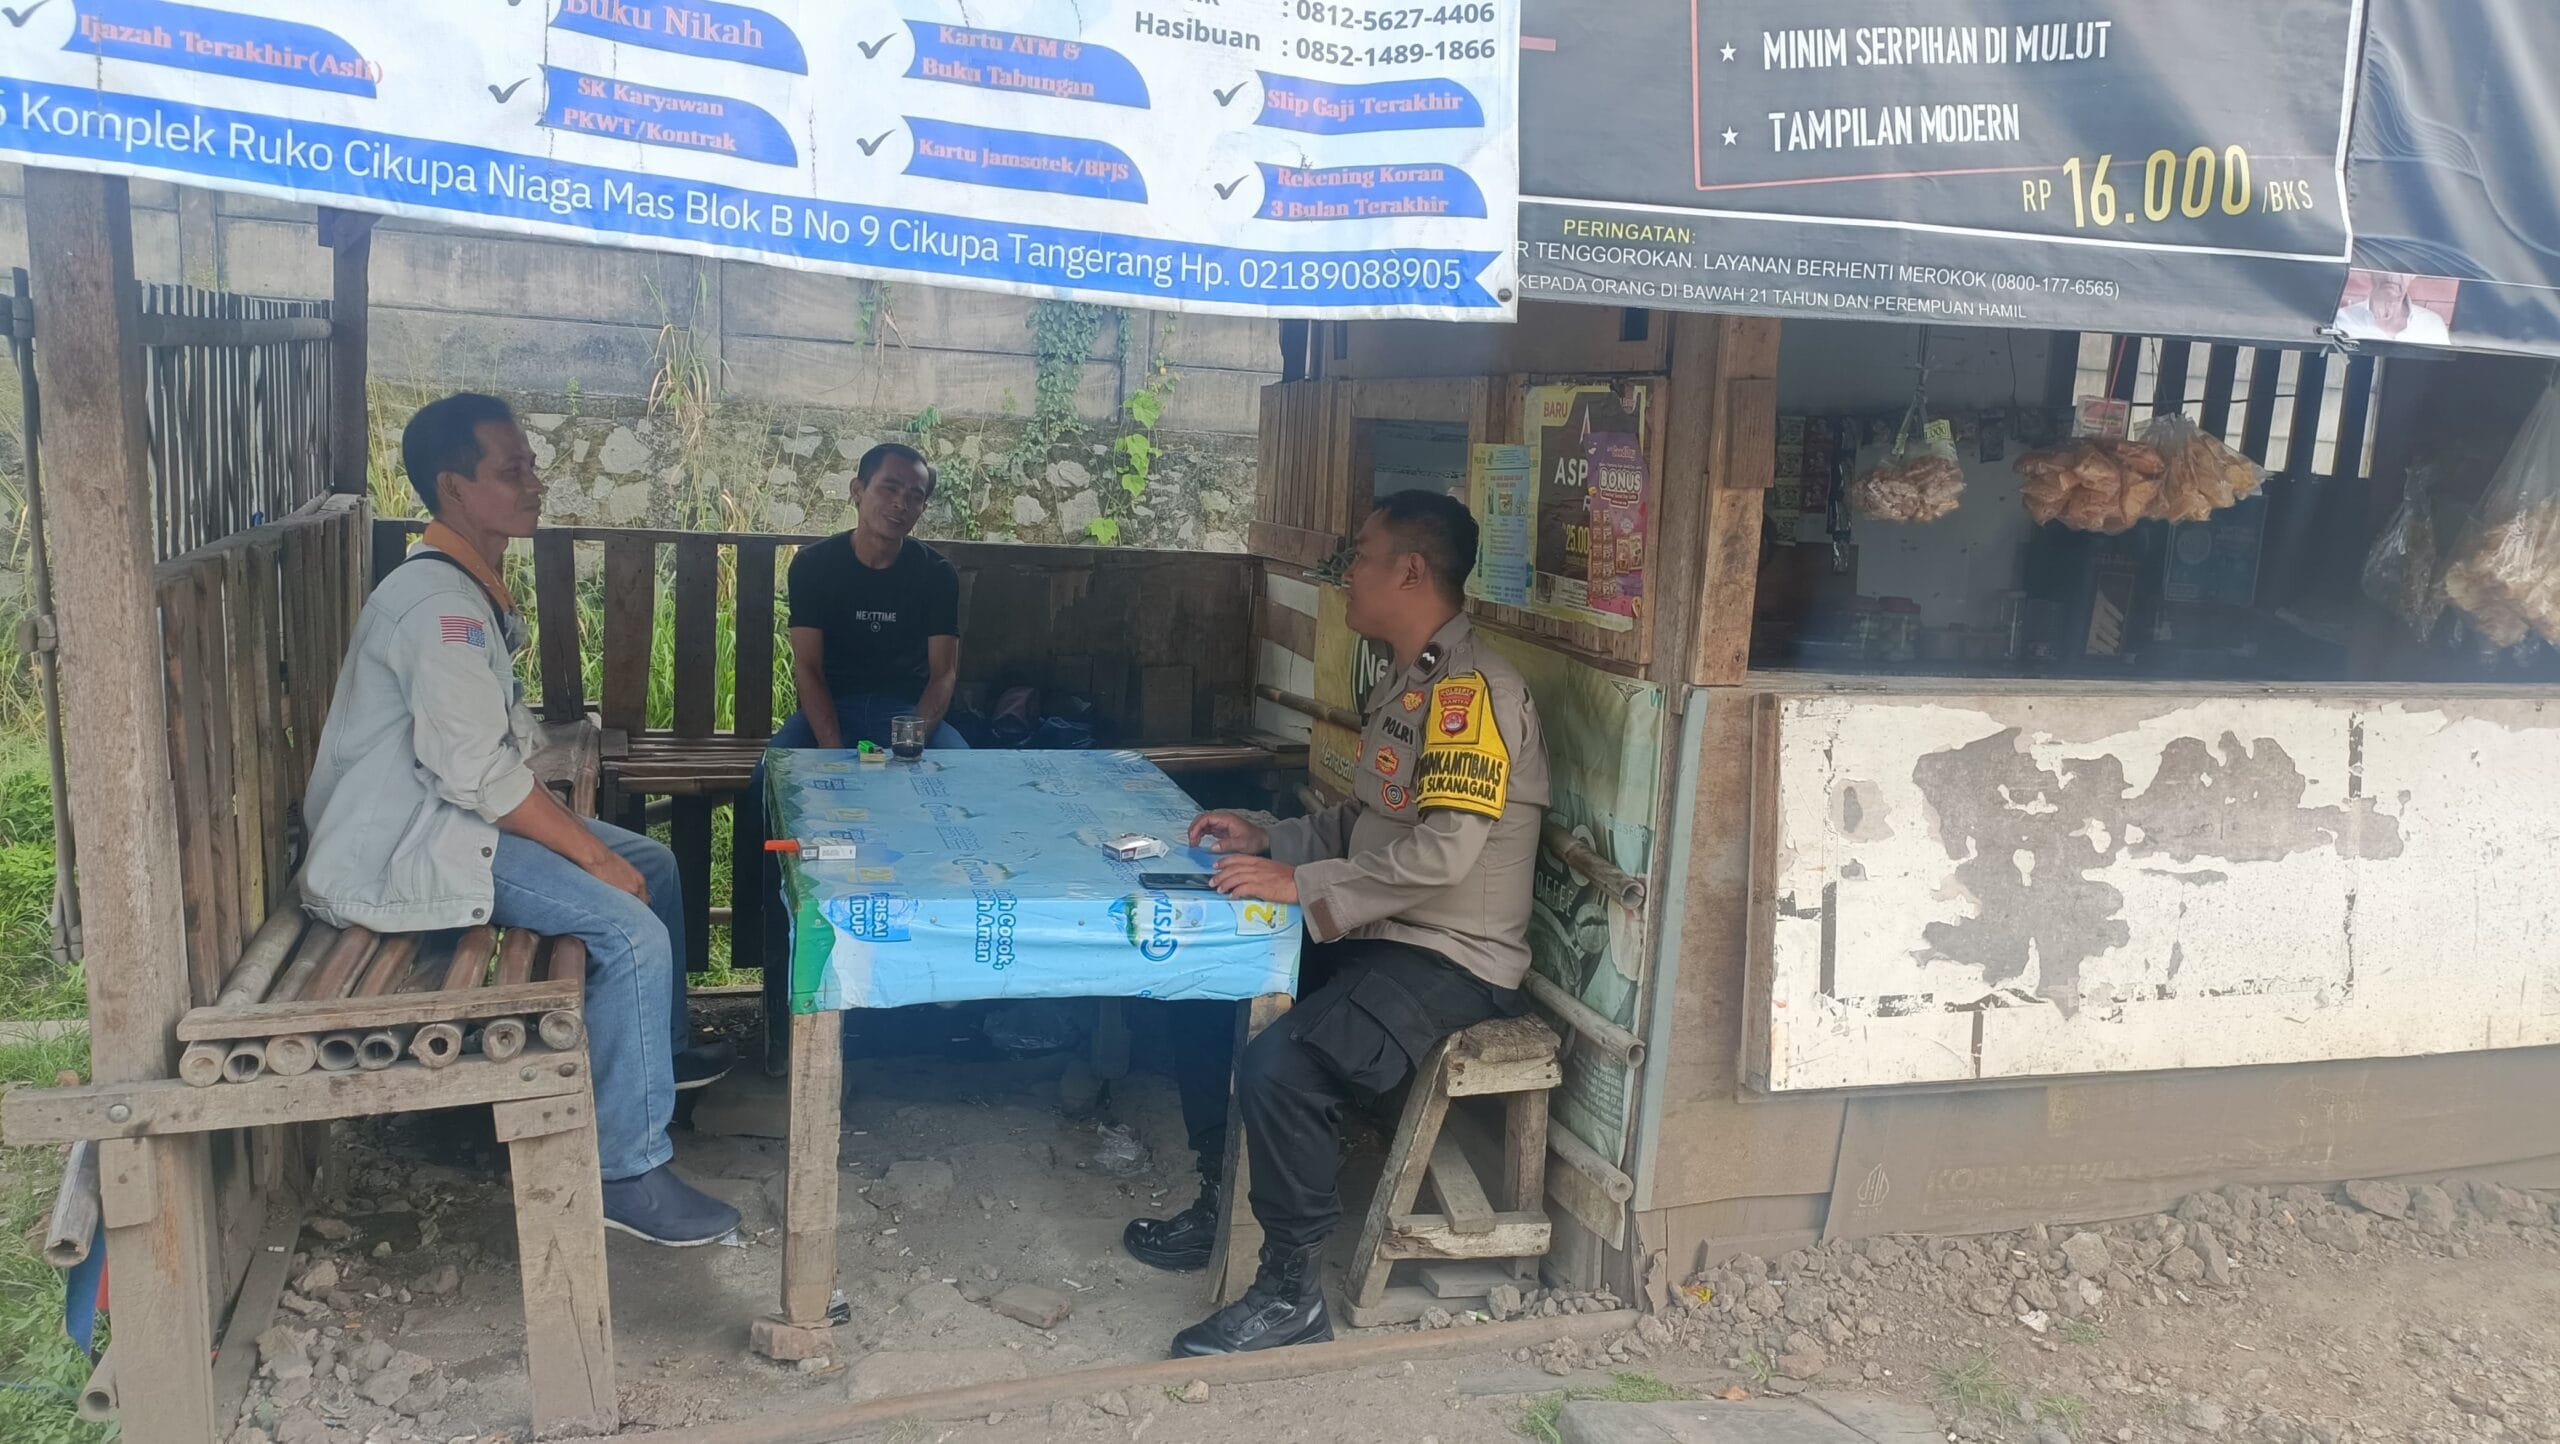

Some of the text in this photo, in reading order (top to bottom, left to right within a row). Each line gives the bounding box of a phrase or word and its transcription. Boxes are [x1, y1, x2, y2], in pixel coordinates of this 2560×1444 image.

[662, 6, 764, 49] Nikah
[1296, 0, 1495, 31] 0812-5627-4406
[80, 14, 384, 84] Ijazah Terakhir(Asli)
[939, 25, 1081, 61] Kartu ATM &
[1135, 11, 1261, 51] Hasibuan
[1296, 37, 1496, 67] 0852-1489-1866
[1763, 21, 2112, 70] MINIM SERPIHAN DI MULUT
[578, 77, 724, 117] SK Karyawan
[922, 56, 1095, 98] Buku Tabungan
[1268, 88, 1464, 123] Slip Gaji Terakhir
[563, 107, 738, 152] PKWT/Kontrak
[1768, 103, 2020, 152] TAMPILAN MODERN
[919, 138, 1130, 182] Kartu Jamsotek/BPJS
[1278, 166, 1445, 189] Rekening Koran
[22, 91, 217, 156] Komplek
[229, 122, 334, 172] Ruko
[344, 140, 478, 196] Cikupa
[488, 161, 593, 214] Niaga
[603, 178, 676, 221] Mas
[686, 190, 763, 233] Blok
[771, 204, 793, 237] B
[804, 208, 850, 244] No
[859, 214, 880, 247] 9
[889, 219, 1000, 266] Cikupa
[1007, 233, 1174, 287] Tangerang
[1180, 252, 1230, 291] Hp.
[1239, 257, 1461, 291] 02189088905
[2022, 144, 2314, 228] RP 16.000 /BKS
[1271, 197, 1449, 218] 3 Bulan Terakhir
[1563, 219, 1697, 245] PERINGATAN:
[1536, 241, 1698, 269] TENGGOROKAN.
[1704, 253, 1791, 275] LAYANAN
[1797, 259, 1894, 281] BERHENTI
[1900, 265, 1986, 288] MEROKOK
[1991, 272, 2120, 300] (0800-177-6565)
[1518, 274, 2027, 319] KEPADA ORANG DI BAWAH 21 TAHUN DAN PEREMPUAN HAMIL
[1543, 400, 1568, 418] BARU
[1600, 468, 1641, 492] BONUS
[856, 610, 897, 622] NEXTTIME
[1382, 716, 1413, 745] POLRI
[1427, 777, 1497, 802] SUKANAGARA
[974, 913, 996, 963] Aman
